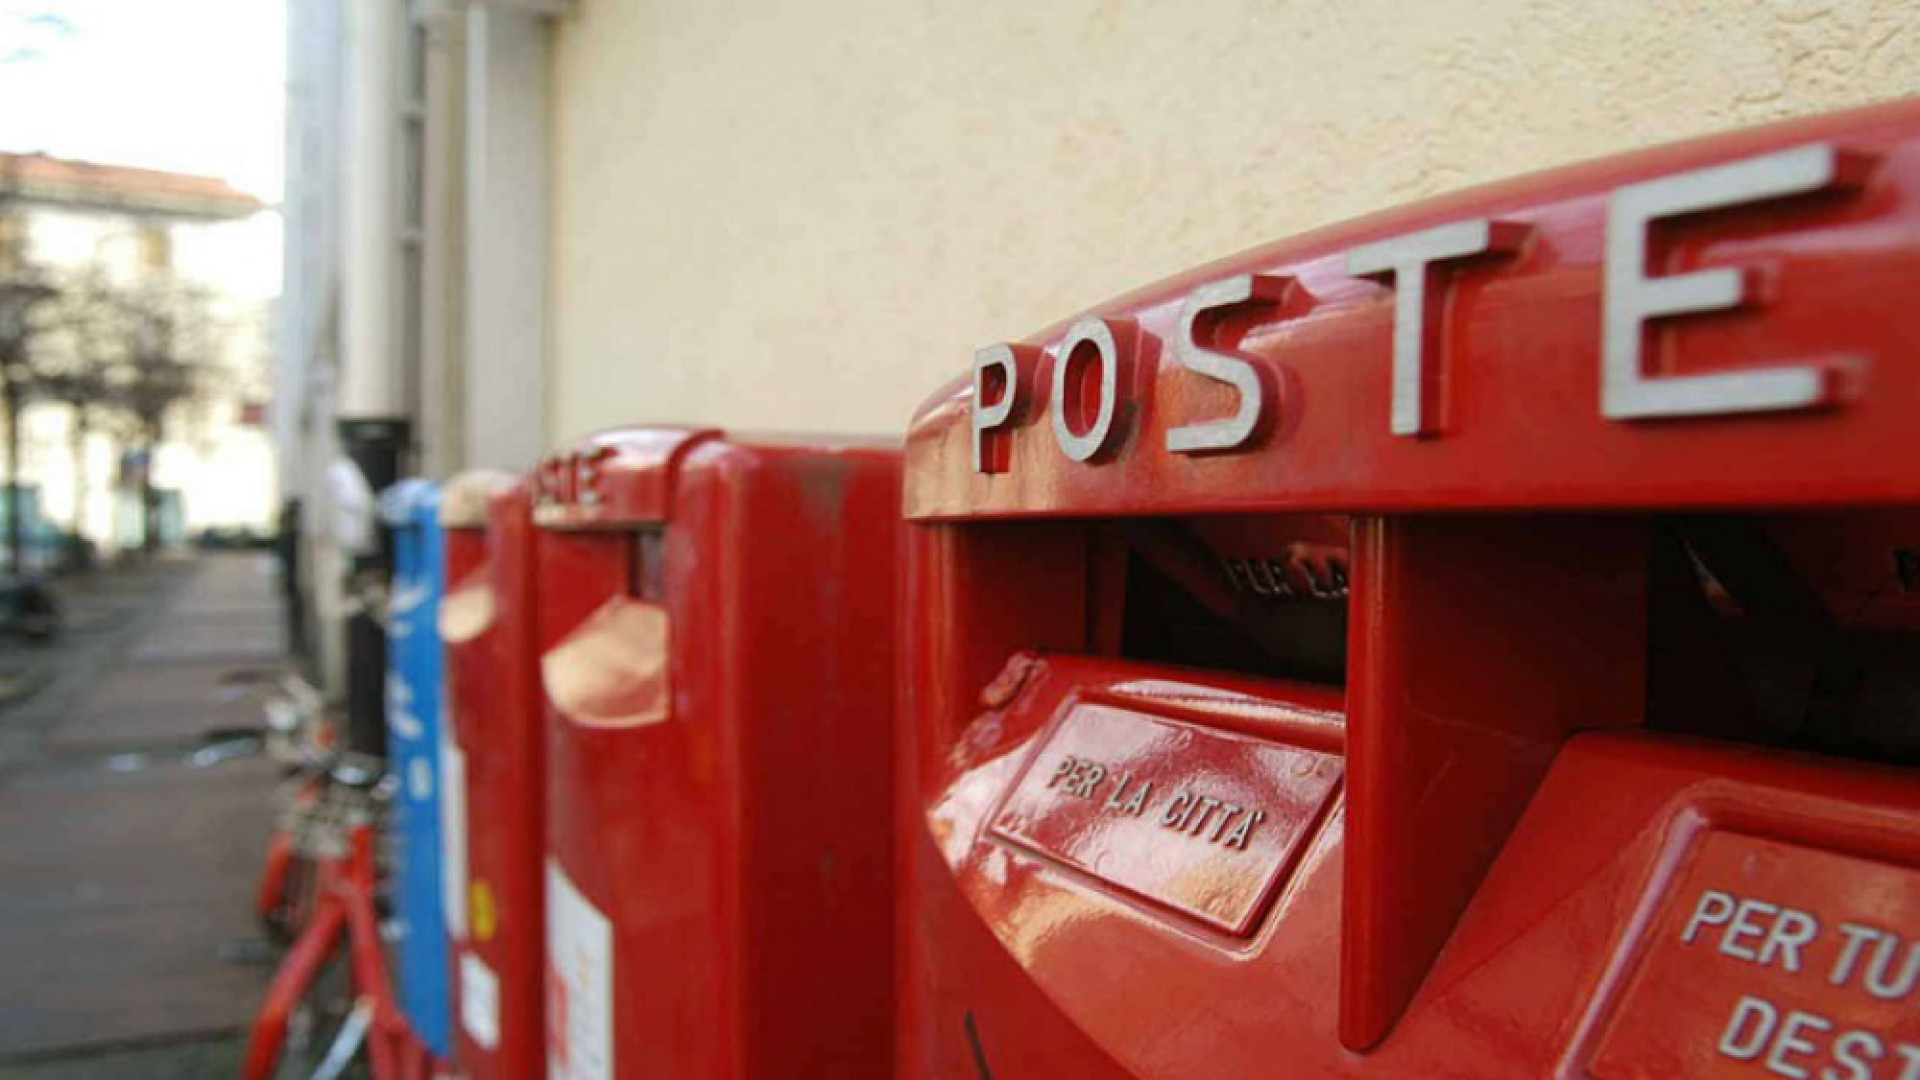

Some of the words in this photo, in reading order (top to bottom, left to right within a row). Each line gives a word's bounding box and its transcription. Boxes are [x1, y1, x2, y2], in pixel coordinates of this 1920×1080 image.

[973, 144, 1838, 474] POSTE
[1048, 755, 1107, 799] PER
[1107, 769, 1153, 818] LA
[1681, 889, 1818, 972] PER
